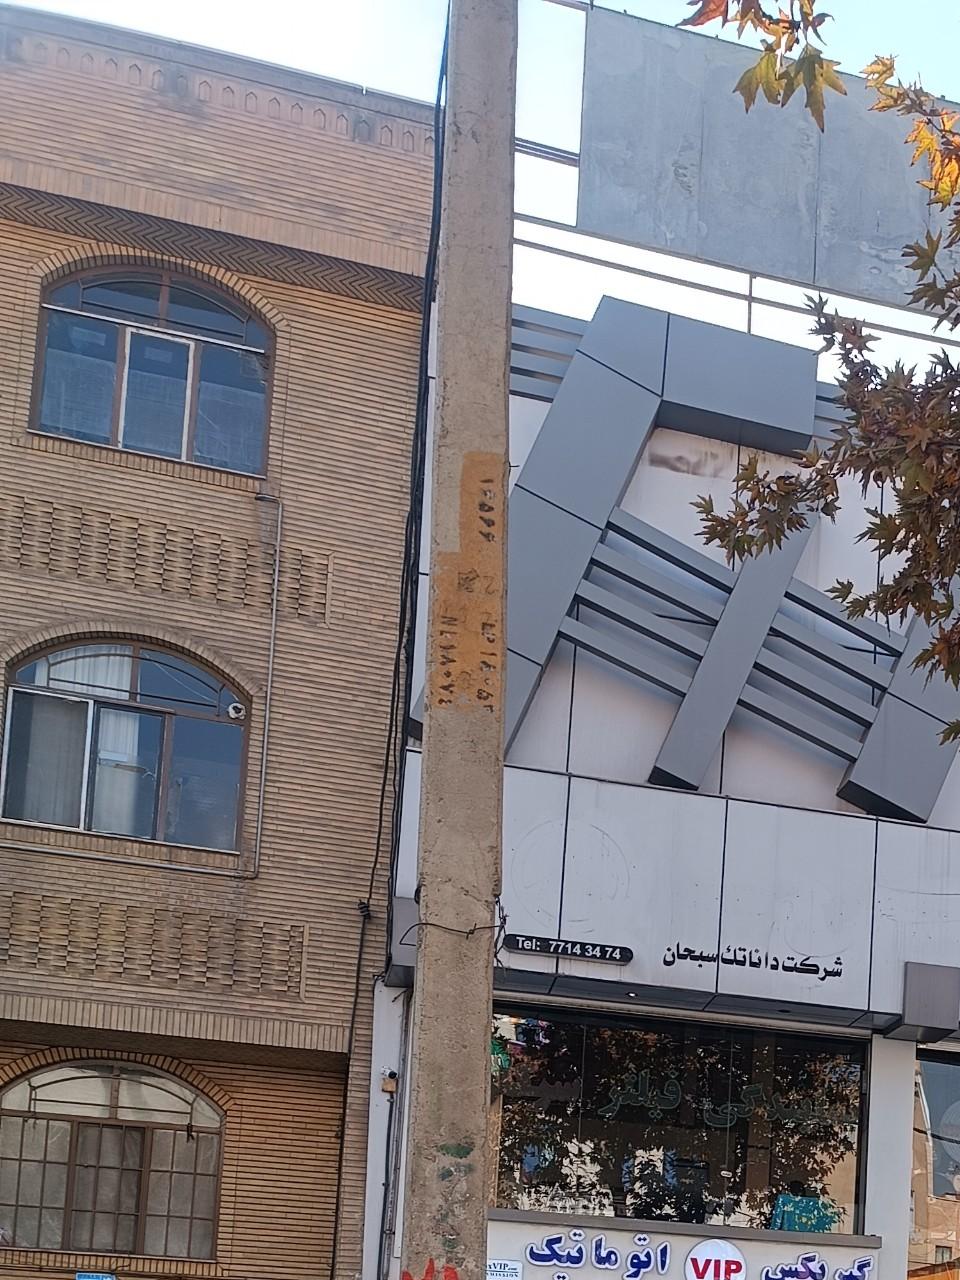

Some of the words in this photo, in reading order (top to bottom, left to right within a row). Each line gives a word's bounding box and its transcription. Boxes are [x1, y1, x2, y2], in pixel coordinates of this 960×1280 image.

[516, 936, 541, 952] Tel:
[549, 940, 582, 955] 7714
[584, 945, 602, 957] 34
[604, 947, 621, 960] 74
[782, 954, 843, 981] شرکت
[690, 1257, 743, 1280] VIP
